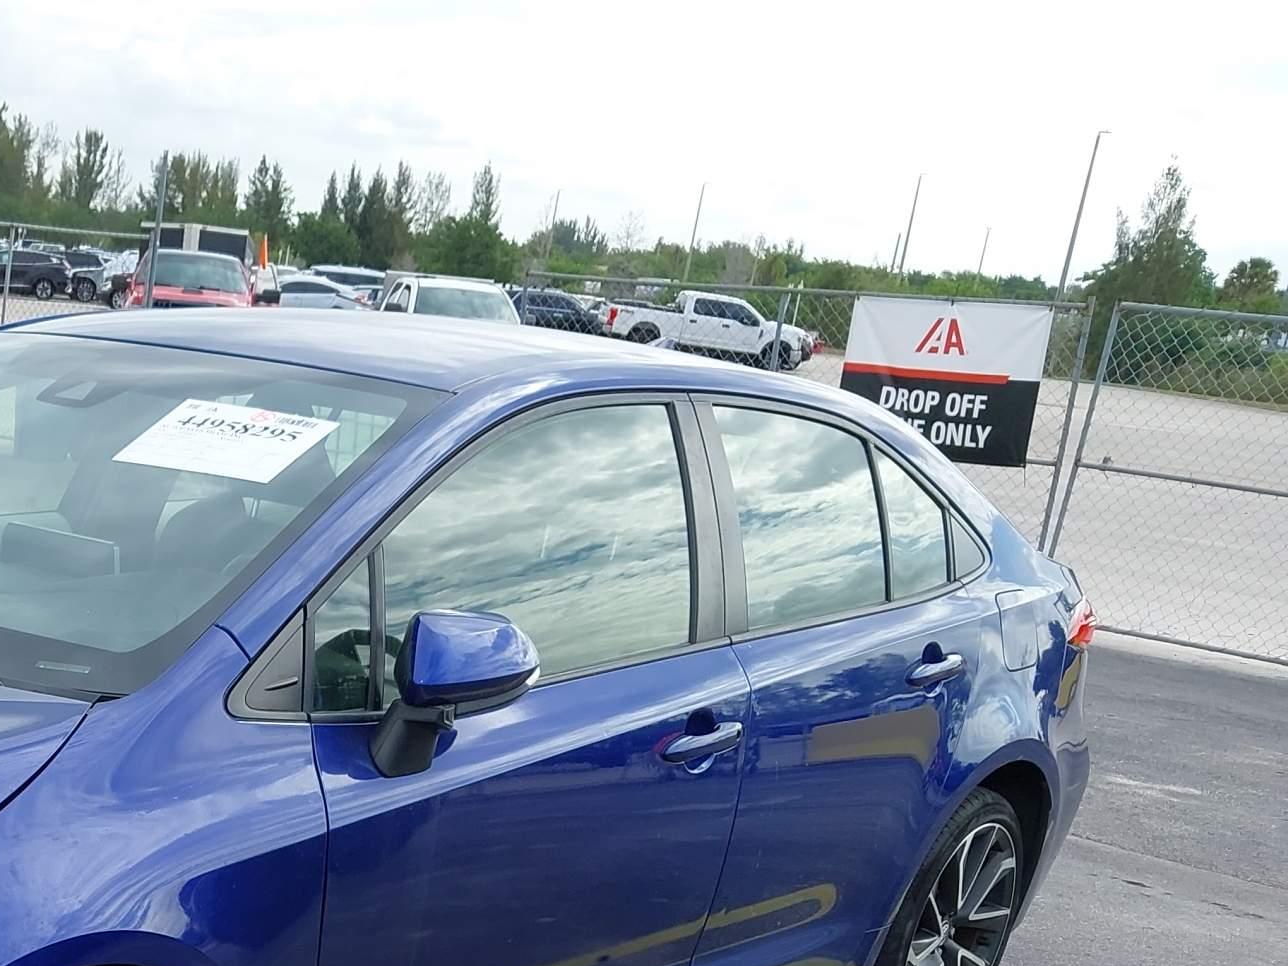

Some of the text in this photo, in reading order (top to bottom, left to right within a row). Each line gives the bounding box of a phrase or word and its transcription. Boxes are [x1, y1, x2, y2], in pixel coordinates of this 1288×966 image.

[915, 317, 965, 356] IAA
[879, 385, 988, 419] DROP OFF
[177, 415, 303, 443] 44958295
[930, 420, 993, 448] ONLY
